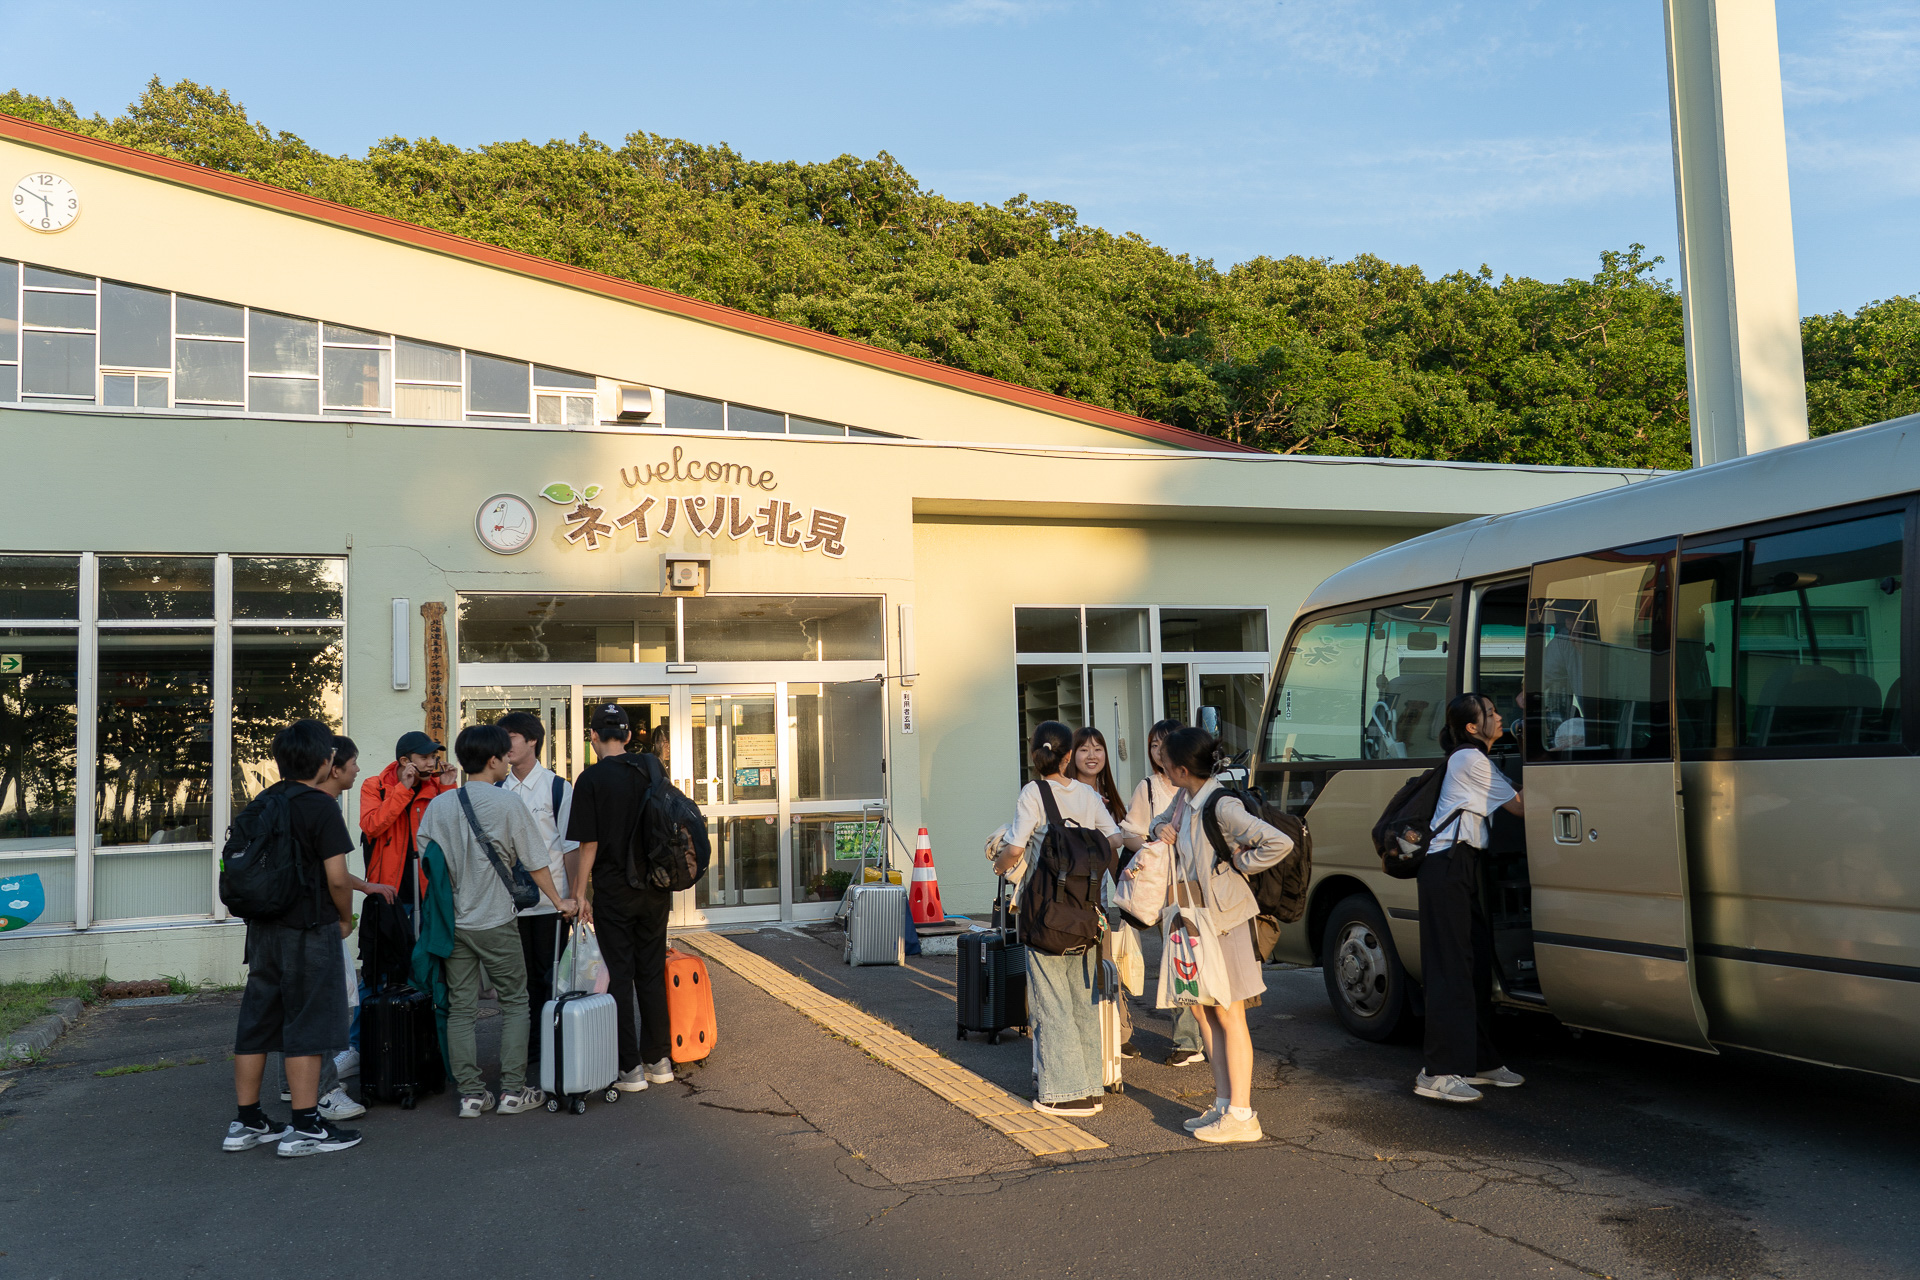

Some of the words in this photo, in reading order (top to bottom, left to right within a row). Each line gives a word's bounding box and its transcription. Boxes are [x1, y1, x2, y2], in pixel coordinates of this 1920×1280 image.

[37, 174, 54, 186] 12
[14, 194, 24, 206] 9
[67, 198, 77, 209] 3
[41, 217, 51, 229] 6
[619, 445, 778, 491] welcome
[563, 495, 849, 559] ネイパル北見
[903, 693, 911, 730] 利用者玄関
